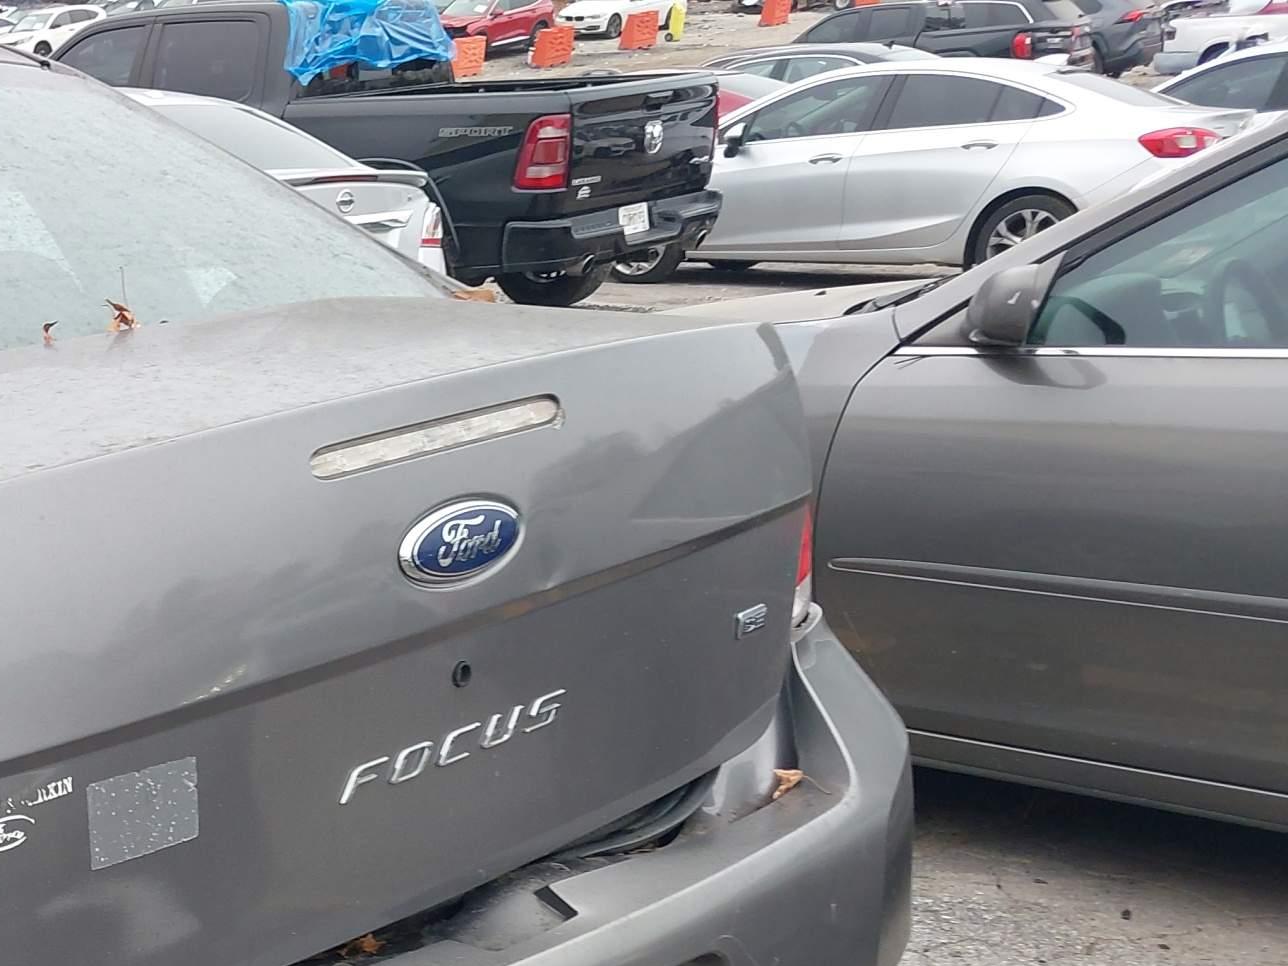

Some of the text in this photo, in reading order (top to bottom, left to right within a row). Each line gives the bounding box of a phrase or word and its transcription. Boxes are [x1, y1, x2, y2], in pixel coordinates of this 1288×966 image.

[438, 126, 513, 137] SPORT
[436, 514, 502, 568] Ford
[338, 688, 567, 805] FOCUS
